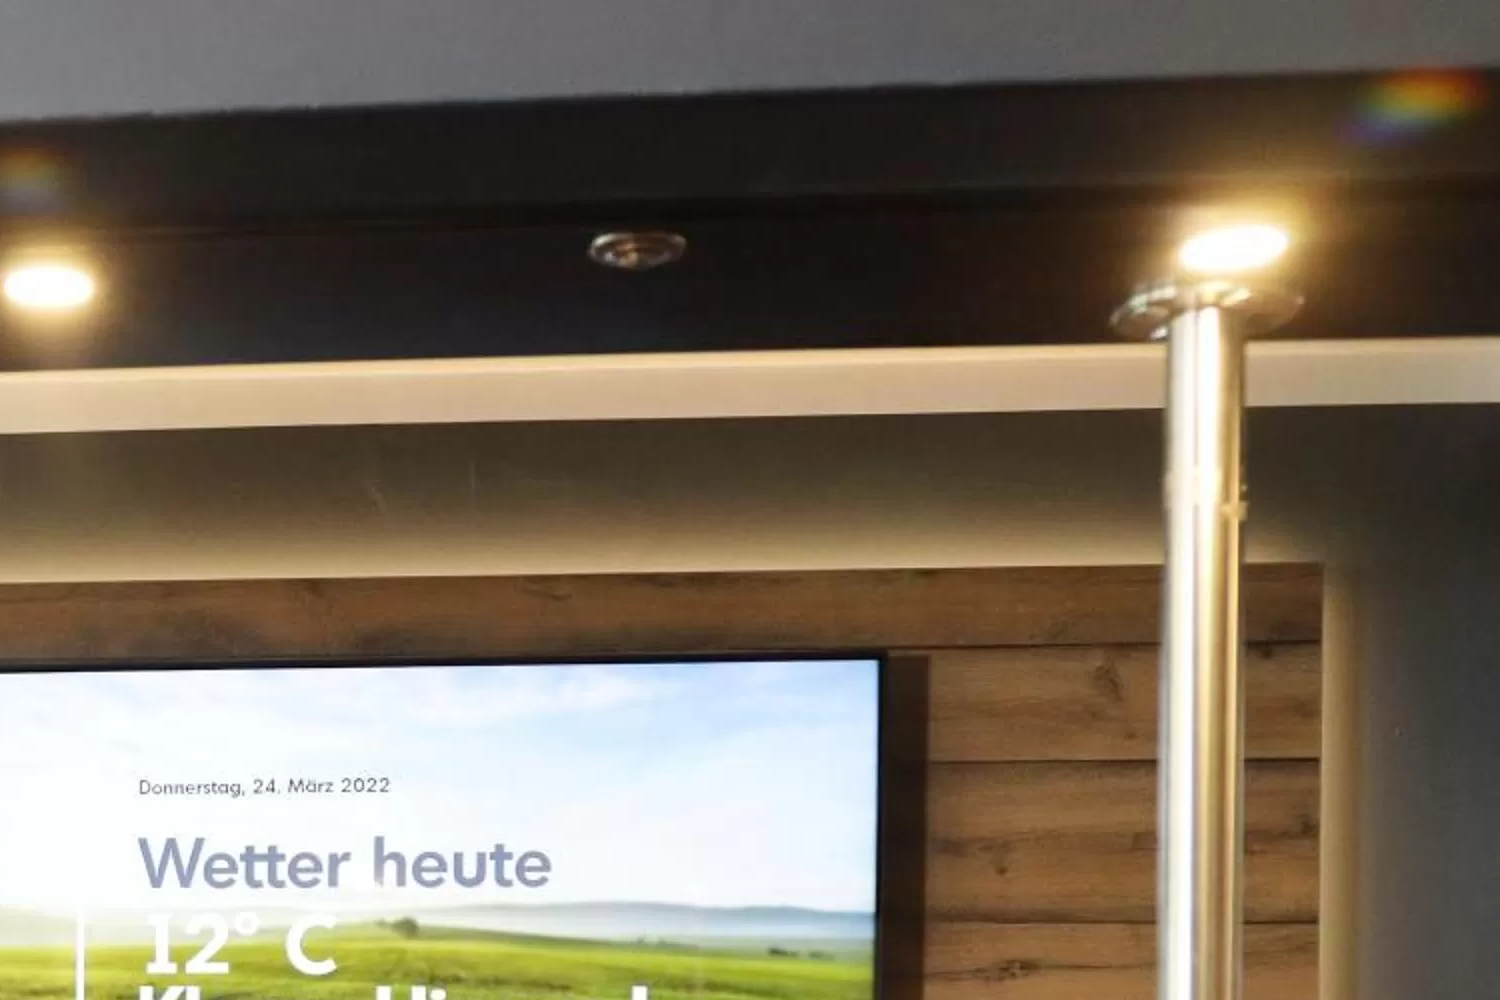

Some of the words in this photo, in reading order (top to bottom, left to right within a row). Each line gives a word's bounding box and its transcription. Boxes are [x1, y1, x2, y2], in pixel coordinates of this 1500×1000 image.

[138, 779, 246, 798] Donnerstag,
[252, 778, 281, 796] 24.
[287, 777, 334, 794] März
[340, 776, 391, 793] 2022
[137, 837, 351, 889] Wetter
[373, 836, 553, 888] heute
[285, 914, 338, 976] C
